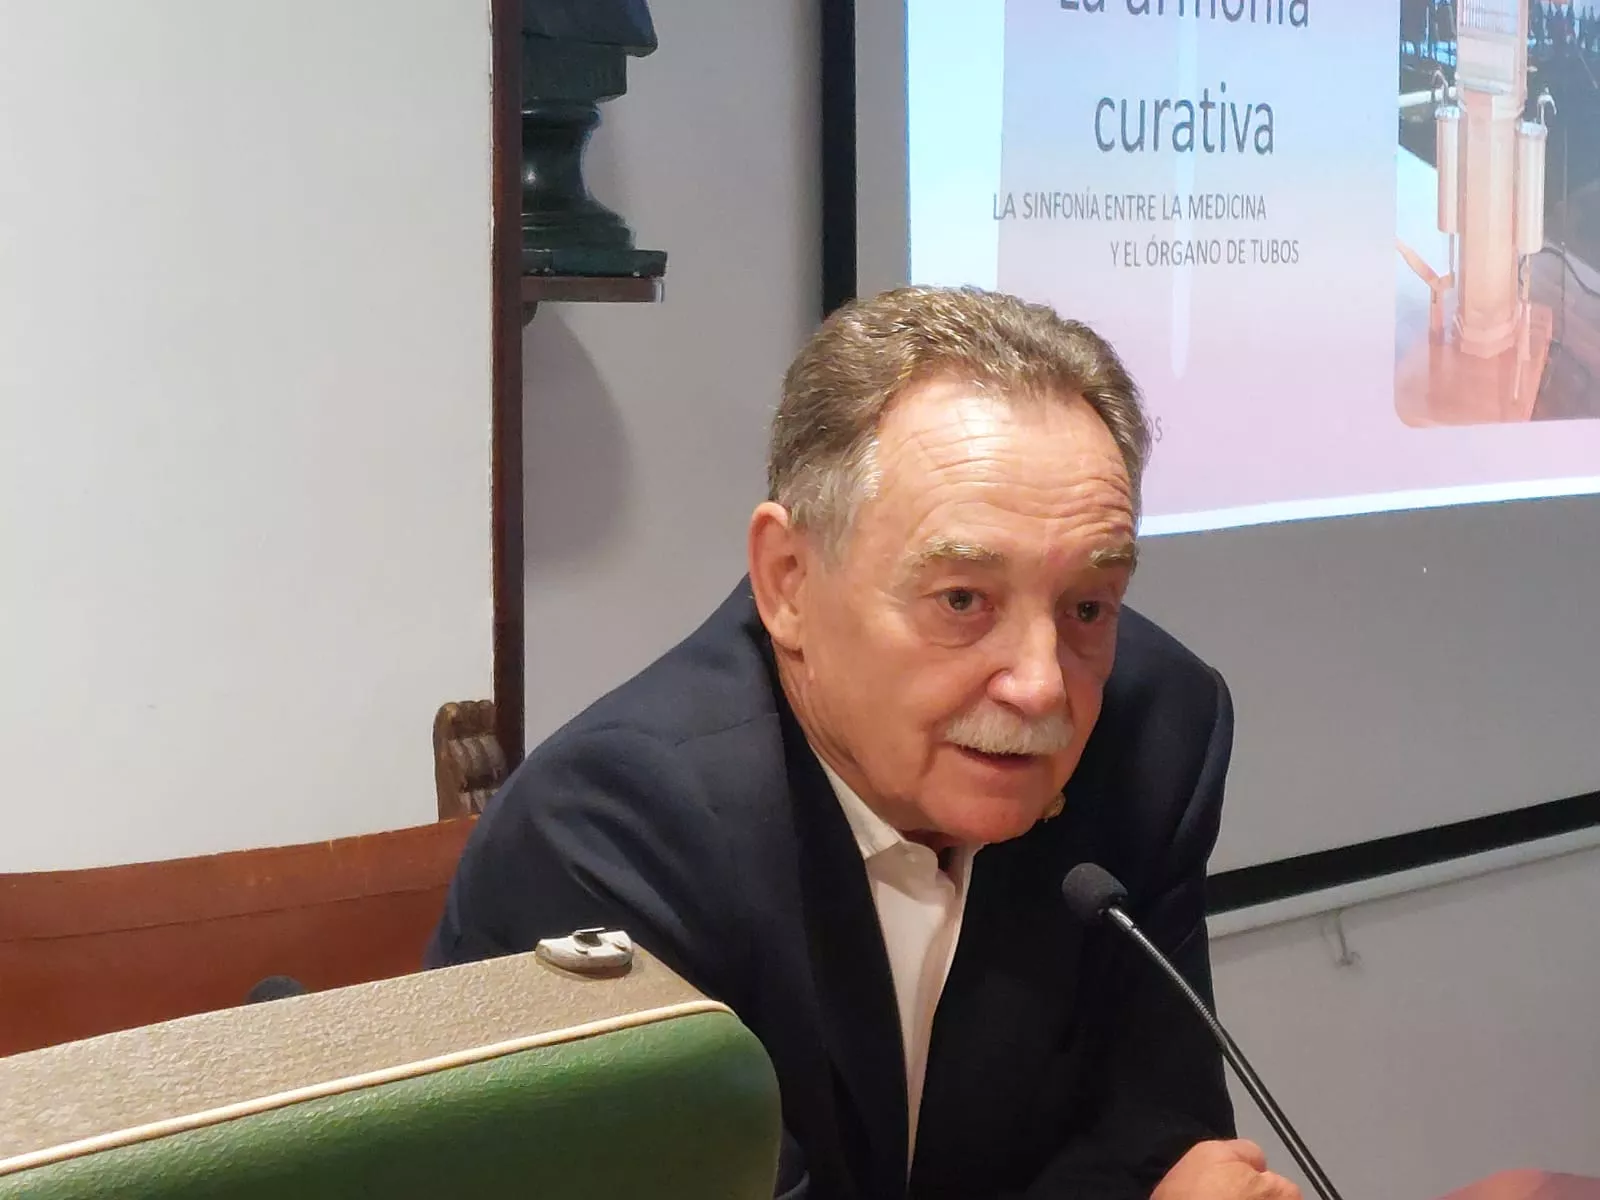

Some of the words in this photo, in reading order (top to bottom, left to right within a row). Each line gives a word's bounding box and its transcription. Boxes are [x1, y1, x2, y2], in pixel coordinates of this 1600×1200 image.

[1095, 81, 1274, 154] curativa
[993, 193, 1016, 220] LA
[1022, 187, 1100, 221] SINFONÍA
[1105, 194, 1157, 221] ENTRE
[1162, 195, 1182, 220] LA
[1188, 194, 1266, 220] MEDICINA
[1110, 241, 1119, 266] Y
[1124, 240, 1141, 267] EL
[1146, 235, 1221, 267] ÓRGANO
[1227, 239, 1246, 265] DE
[1251, 239, 1299, 265] TUBOS
